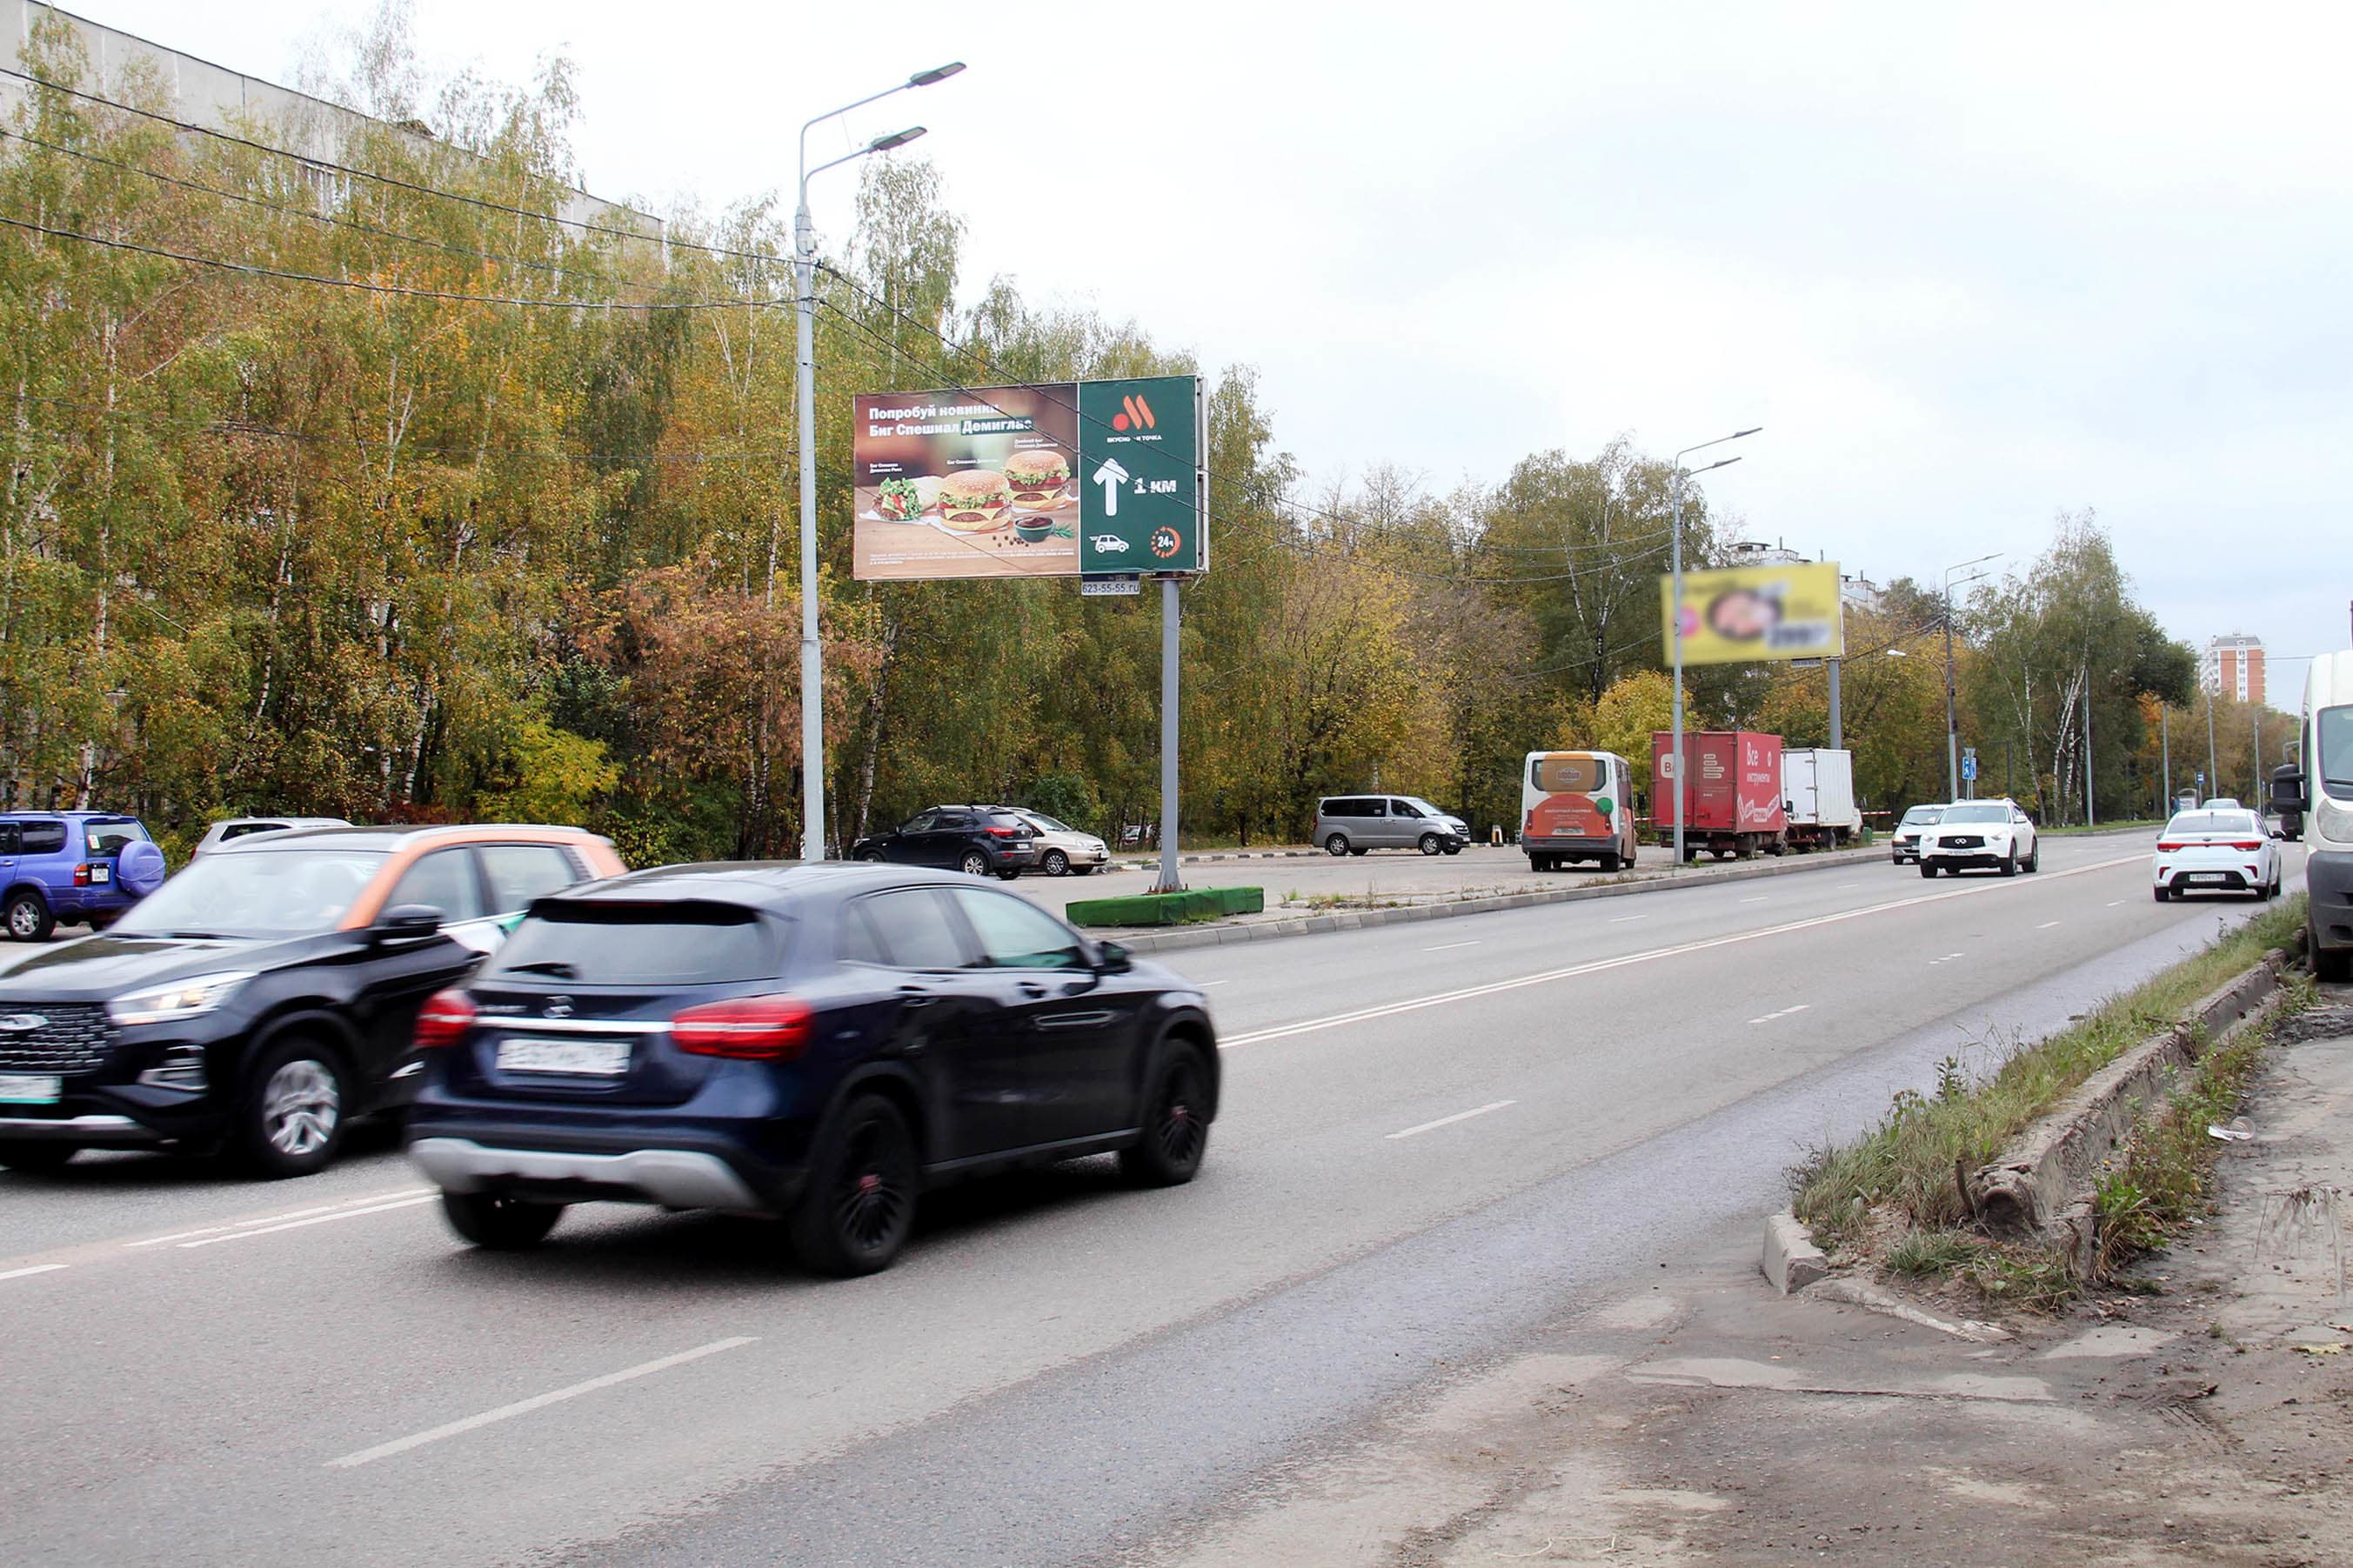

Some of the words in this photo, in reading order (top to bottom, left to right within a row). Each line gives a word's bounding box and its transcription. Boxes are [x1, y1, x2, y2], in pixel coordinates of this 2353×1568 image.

[870, 404, 936, 421] Попробуй
[870, 424, 893, 437] Биг
[897, 421, 959, 436] Спешиал
[962, 419, 1033, 435] Демиглас
[1133, 477, 1146, 495] 1
[1157, 536, 1173, 548] 24ч
